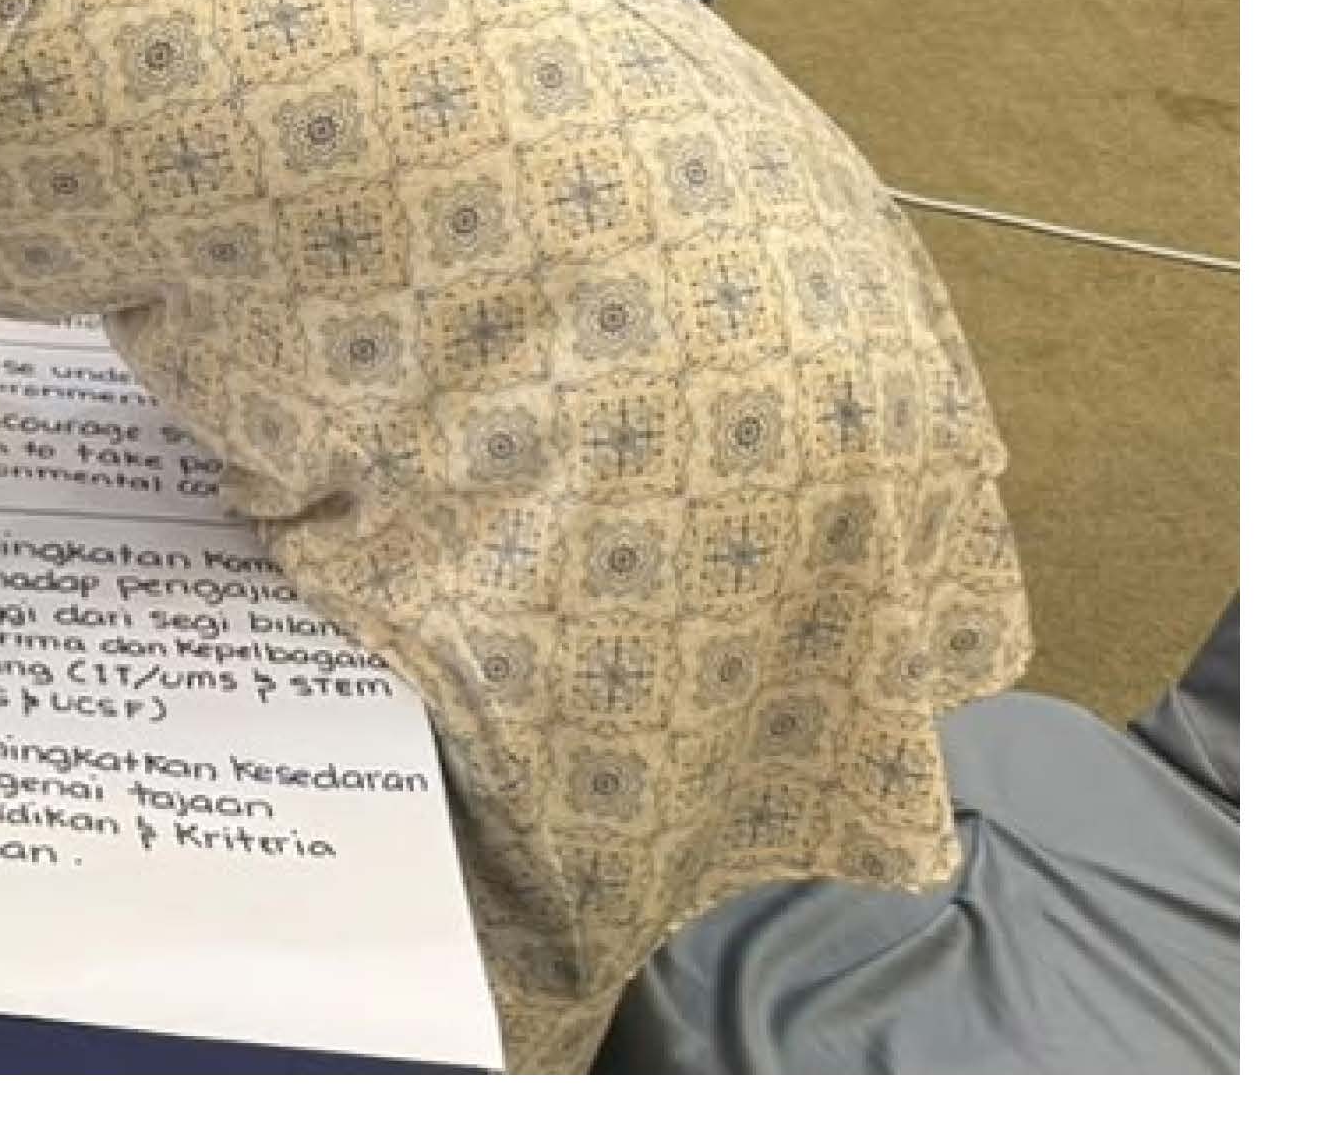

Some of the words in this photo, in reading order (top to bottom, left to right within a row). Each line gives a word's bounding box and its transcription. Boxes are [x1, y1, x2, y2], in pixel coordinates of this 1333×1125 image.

[51, 364, 136, 384] unde
[23, 440, 57, 460] to
[77, 444, 164, 470] take
[118, 575, 298, 605] pengajia
[53, 602, 133, 629] dari
[148, 608, 231, 638] segi
[249, 612, 345, 638] bilan
[99, 636, 168, 659] dan
[128, 780, 275, 820] tajaan
[174, 821, 337, 861] Kriteria
